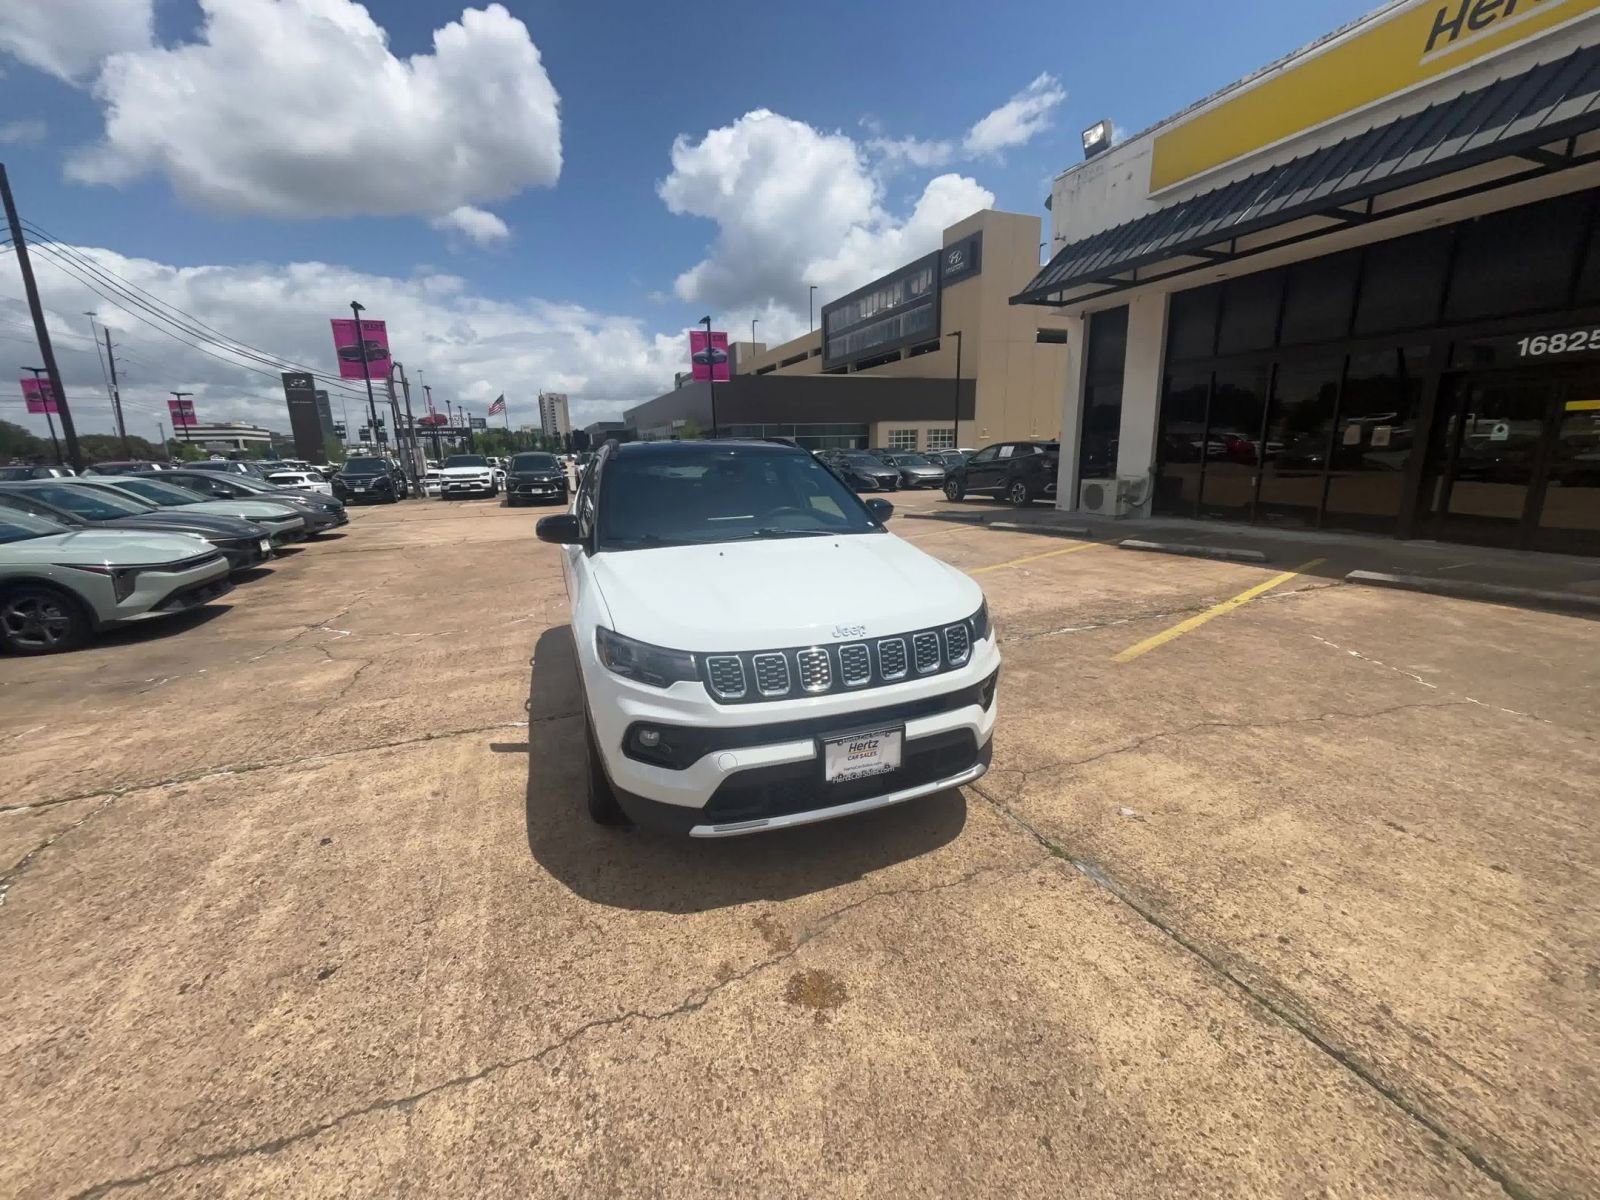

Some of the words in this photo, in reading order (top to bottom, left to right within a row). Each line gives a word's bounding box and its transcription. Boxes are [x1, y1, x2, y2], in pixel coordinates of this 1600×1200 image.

[1517, 329, 1600, 357] 16825
[832, 624, 867, 639] Jeep
[848, 739, 879, 753] Hertz
